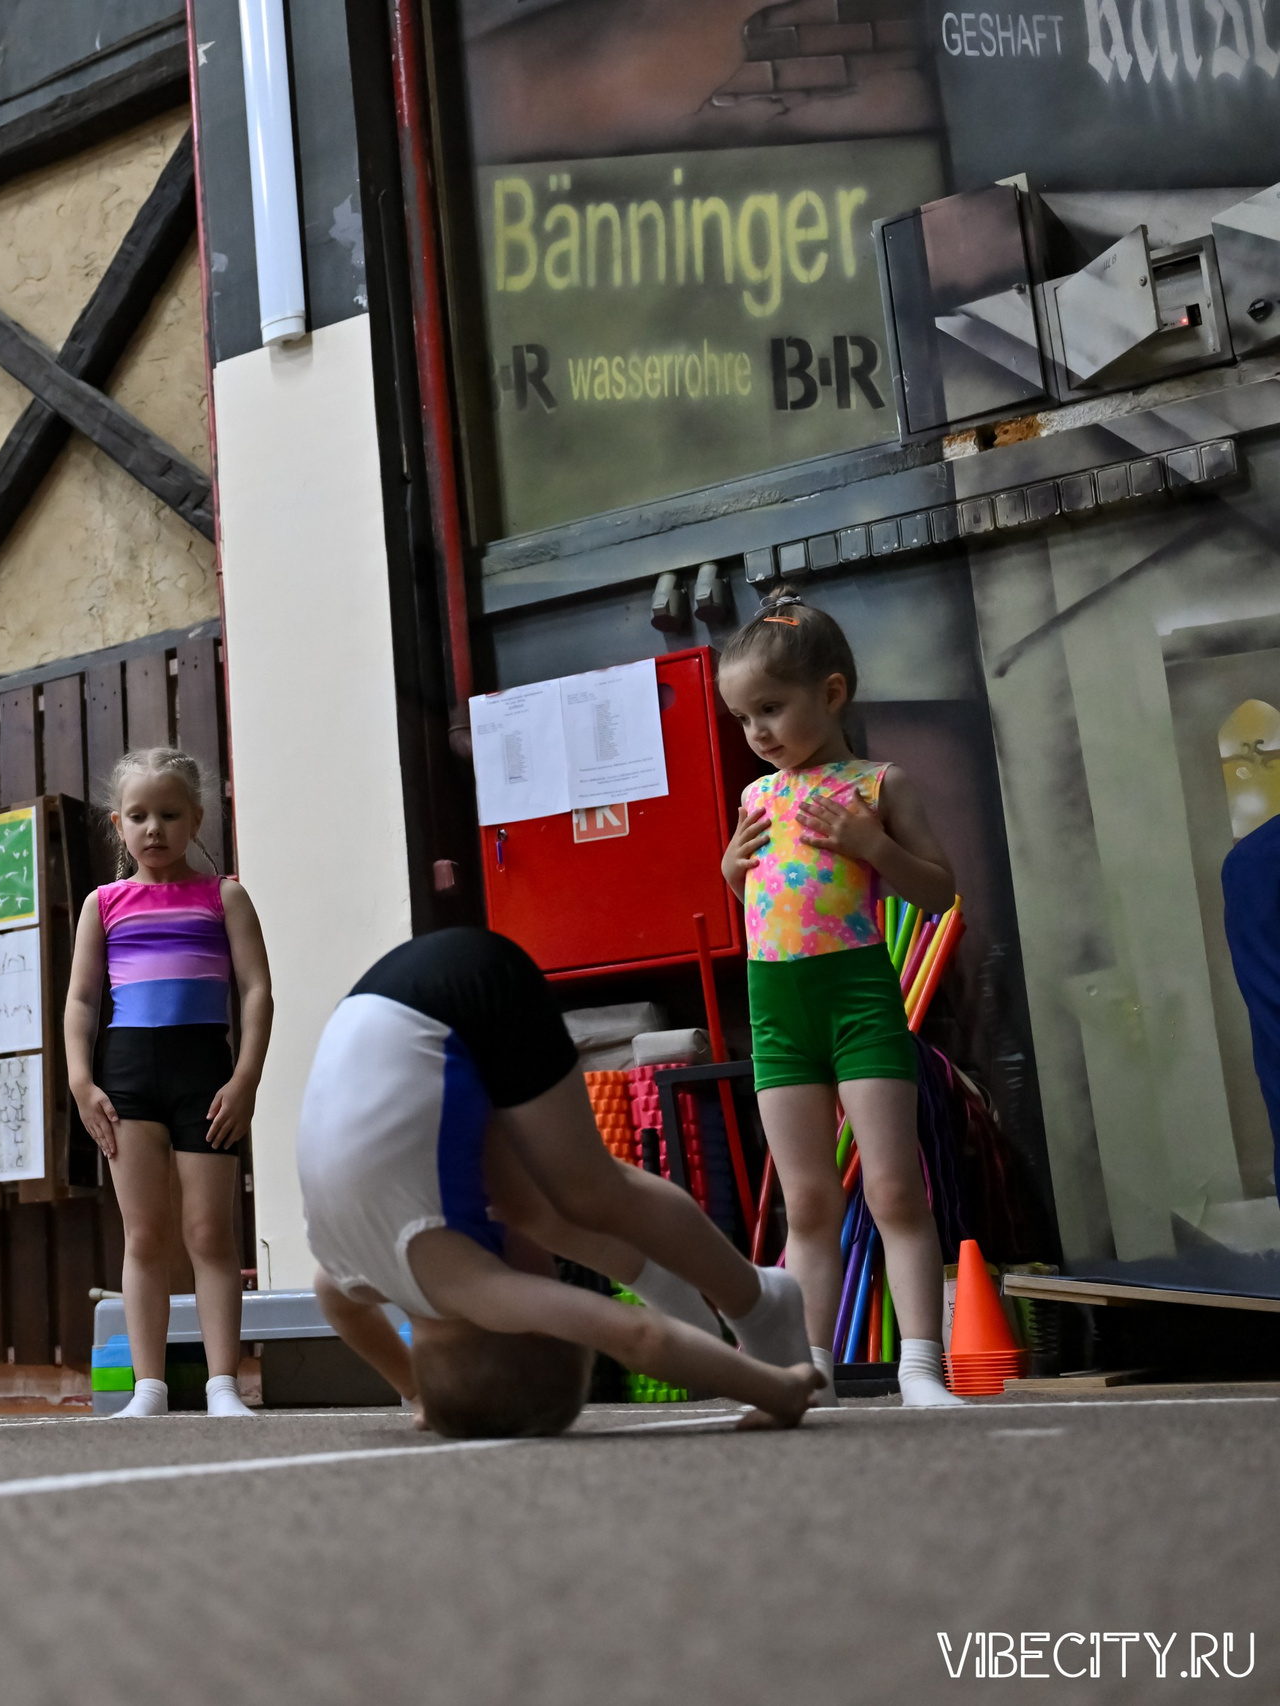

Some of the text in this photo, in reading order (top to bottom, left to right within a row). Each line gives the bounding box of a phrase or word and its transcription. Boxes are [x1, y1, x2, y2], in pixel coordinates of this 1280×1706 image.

[941, 12, 1064, 57] GESHAFT
[493, 168, 868, 318] Bänninger
[568, 338, 752, 400] wasserrohre
